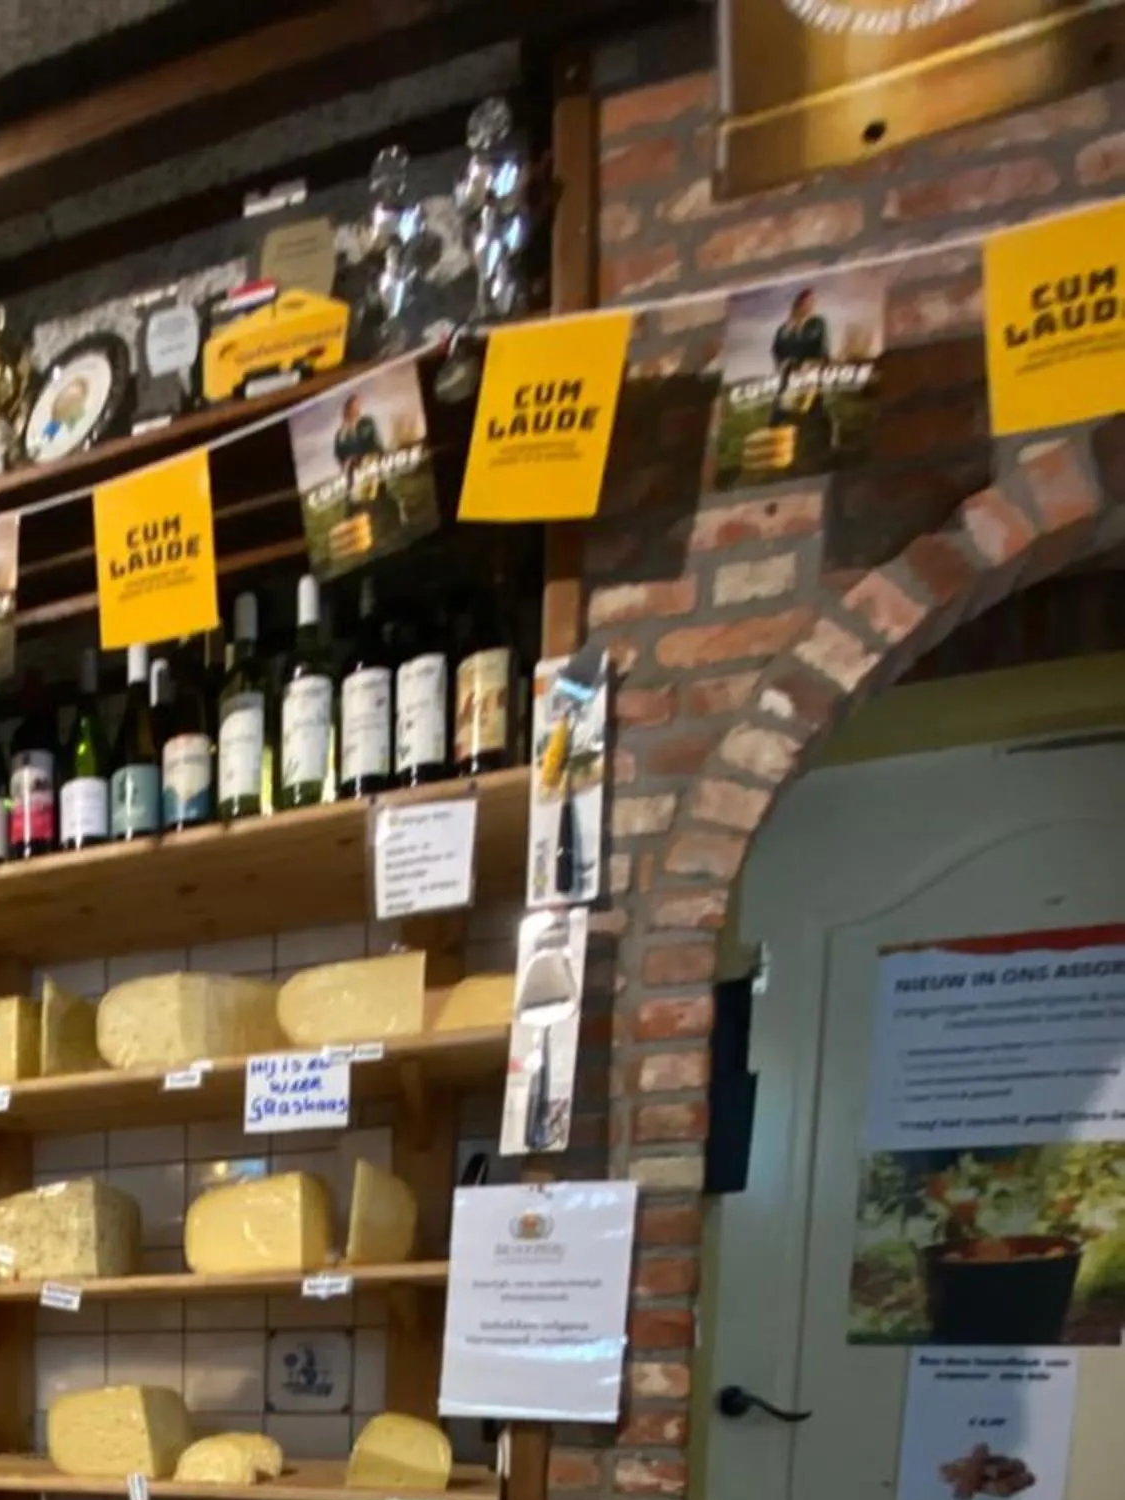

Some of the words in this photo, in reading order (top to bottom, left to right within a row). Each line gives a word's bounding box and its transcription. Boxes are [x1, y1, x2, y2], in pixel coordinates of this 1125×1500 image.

[1030, 265, 1116, 312] CUM
[1004, 296, 1125, 348] LAUD
[514, 379, 583, 409] CUM
[487, 405, 599, 441] LAUDE
[126, 514, 180, 549] CUM
[109, 533, 201, 580] LAUDE
[894, 974, 967, 994] NIEUW
[971, 970, 996, 987] IN
[1001, 964, 1050, 985] ONS
